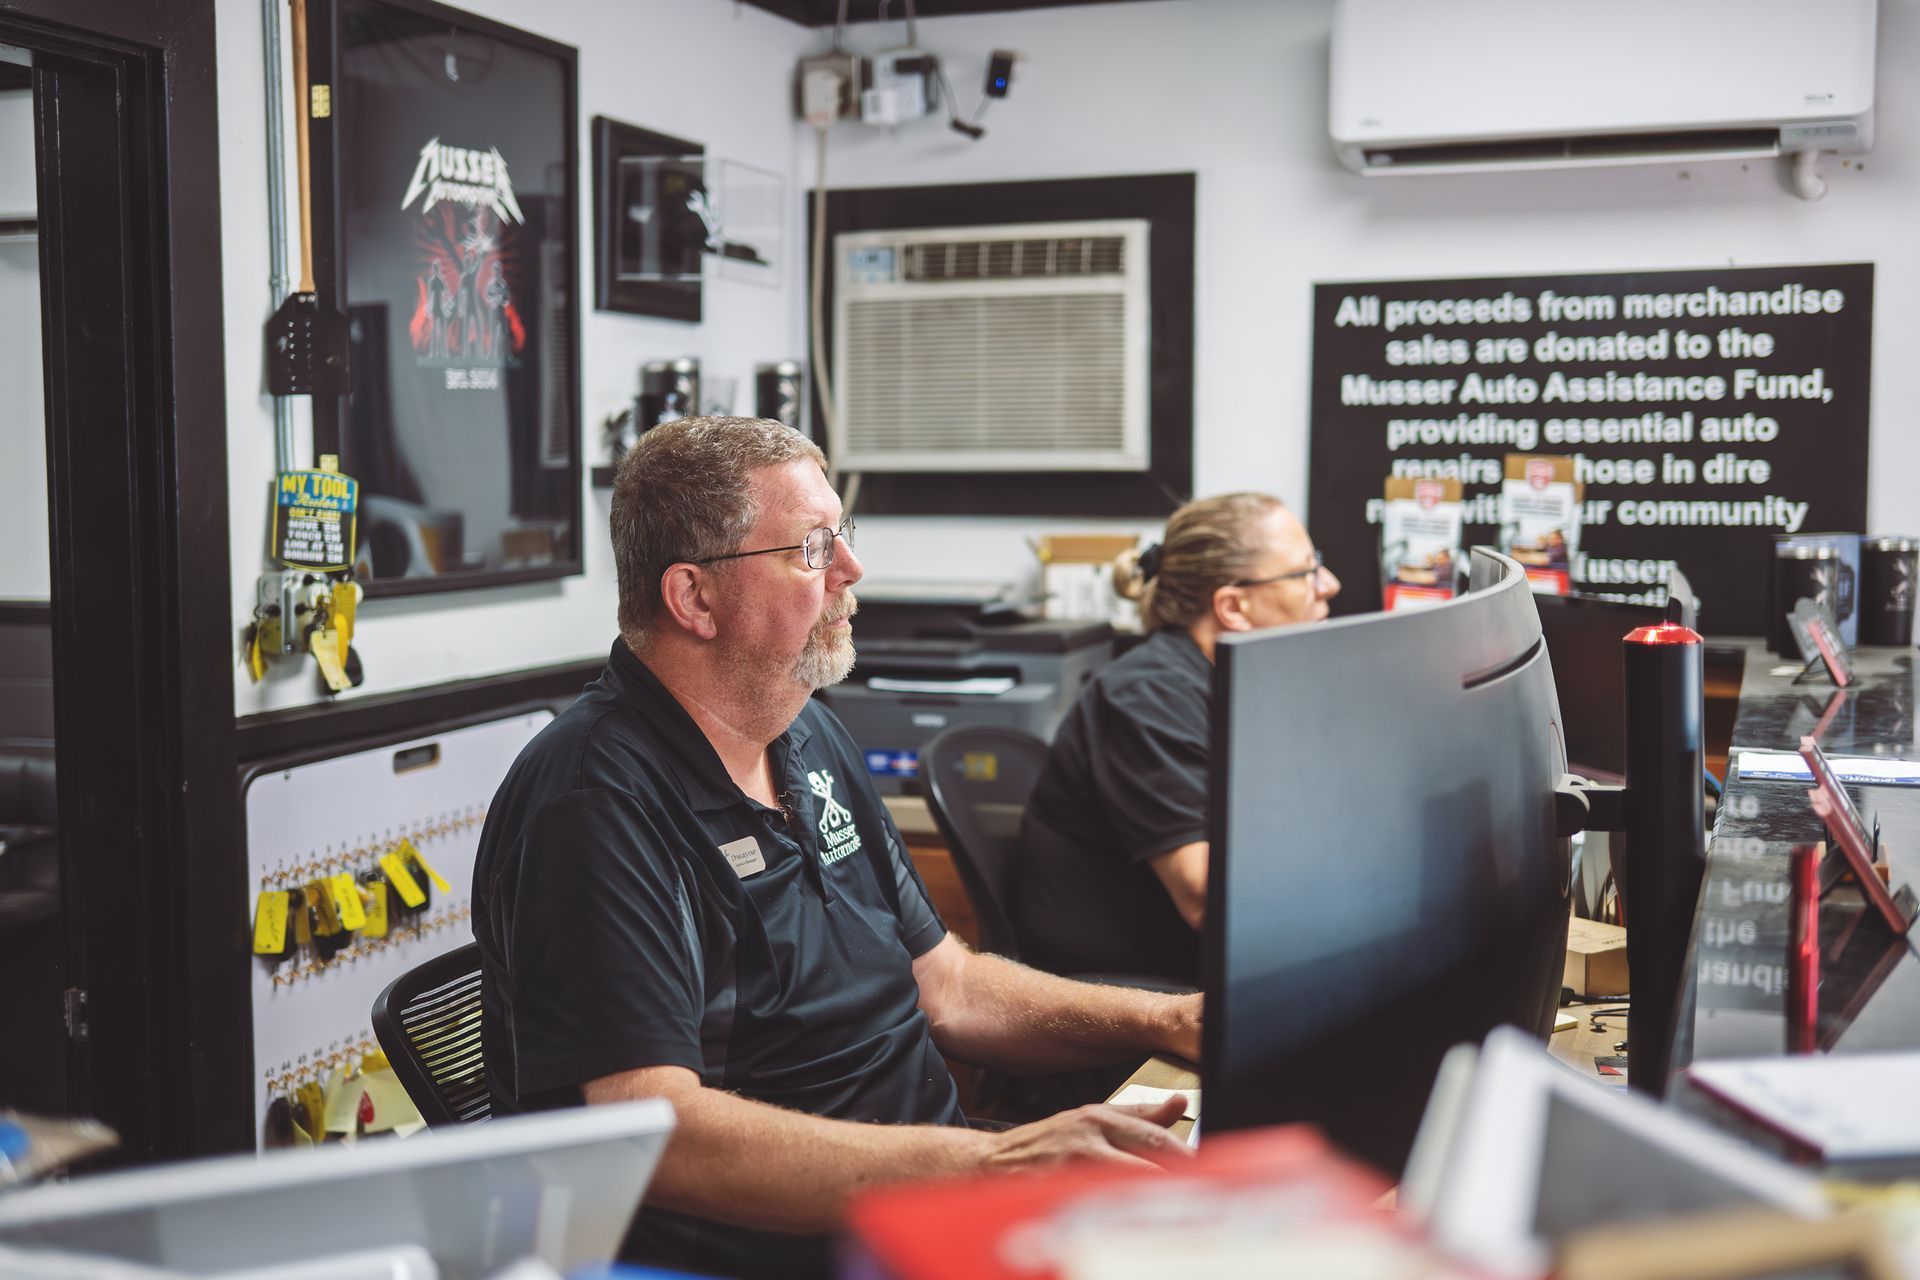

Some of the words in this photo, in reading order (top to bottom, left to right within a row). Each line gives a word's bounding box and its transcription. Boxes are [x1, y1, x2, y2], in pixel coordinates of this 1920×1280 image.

[1335, 296, 1380, 328] All
[1385, 292, 1533, 332] proceeds
[1538, 290, 1616, 322] from
[1622, 283, 1845, 319] merchandise
[1385, 333, 1470, 366] sales
[1475, 337, 1529, 364] are
[1534, 330, 1670, 362] donated
[1675, 329, 1712, 360] to
[1717, 327, 1775, 358] the
[1340, 374, 1457, 406] Musser
[1459, 372, 1539, 404] Auto
[1542, 370, 1727, 403] Assistance
[1733, 368, 1834, 404] Fund,
[1387, 413, 1539, 450] providing
[1544, 411, 1694, 443] essential
[1700, 412, 1779, 442] auto
[283, 474, 307, 498] MY
[312, 475, 351, 499] TOOL
[1573, 453, 1656, 484] hose
[1662, 453, 1696, 484] in
[1702, 453, 1771, 484] dire
[288, 520, 319, 530] MOVE
[1579, 500, 1612, 525] ur
[1617, 495, 1809, 532] community
[823, 824, 856, 849] Musser
